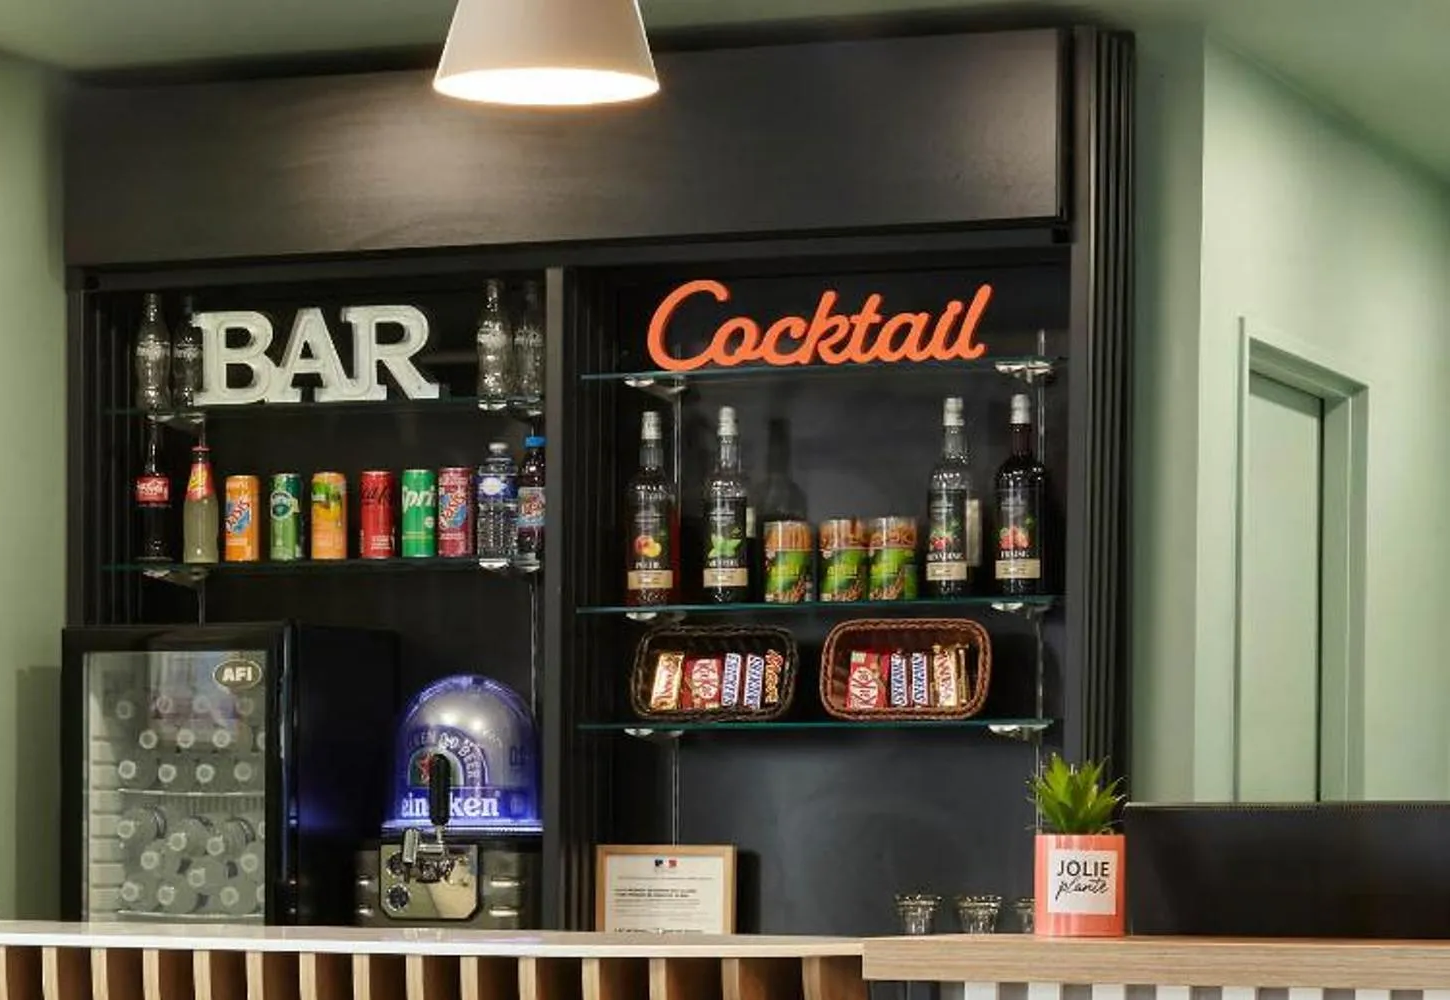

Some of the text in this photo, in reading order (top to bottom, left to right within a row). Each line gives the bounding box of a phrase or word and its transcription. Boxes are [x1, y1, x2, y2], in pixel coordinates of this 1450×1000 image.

[648, 279, 993, 371] Cocktail
[191, 305, 439, 405] BAR
[222, 666, 252, 682] AFI
[401, 791, 499, 817] einken
[1057, 860, 1110, 877] JOLIE
[1055, 876, 1109, 901] plante
